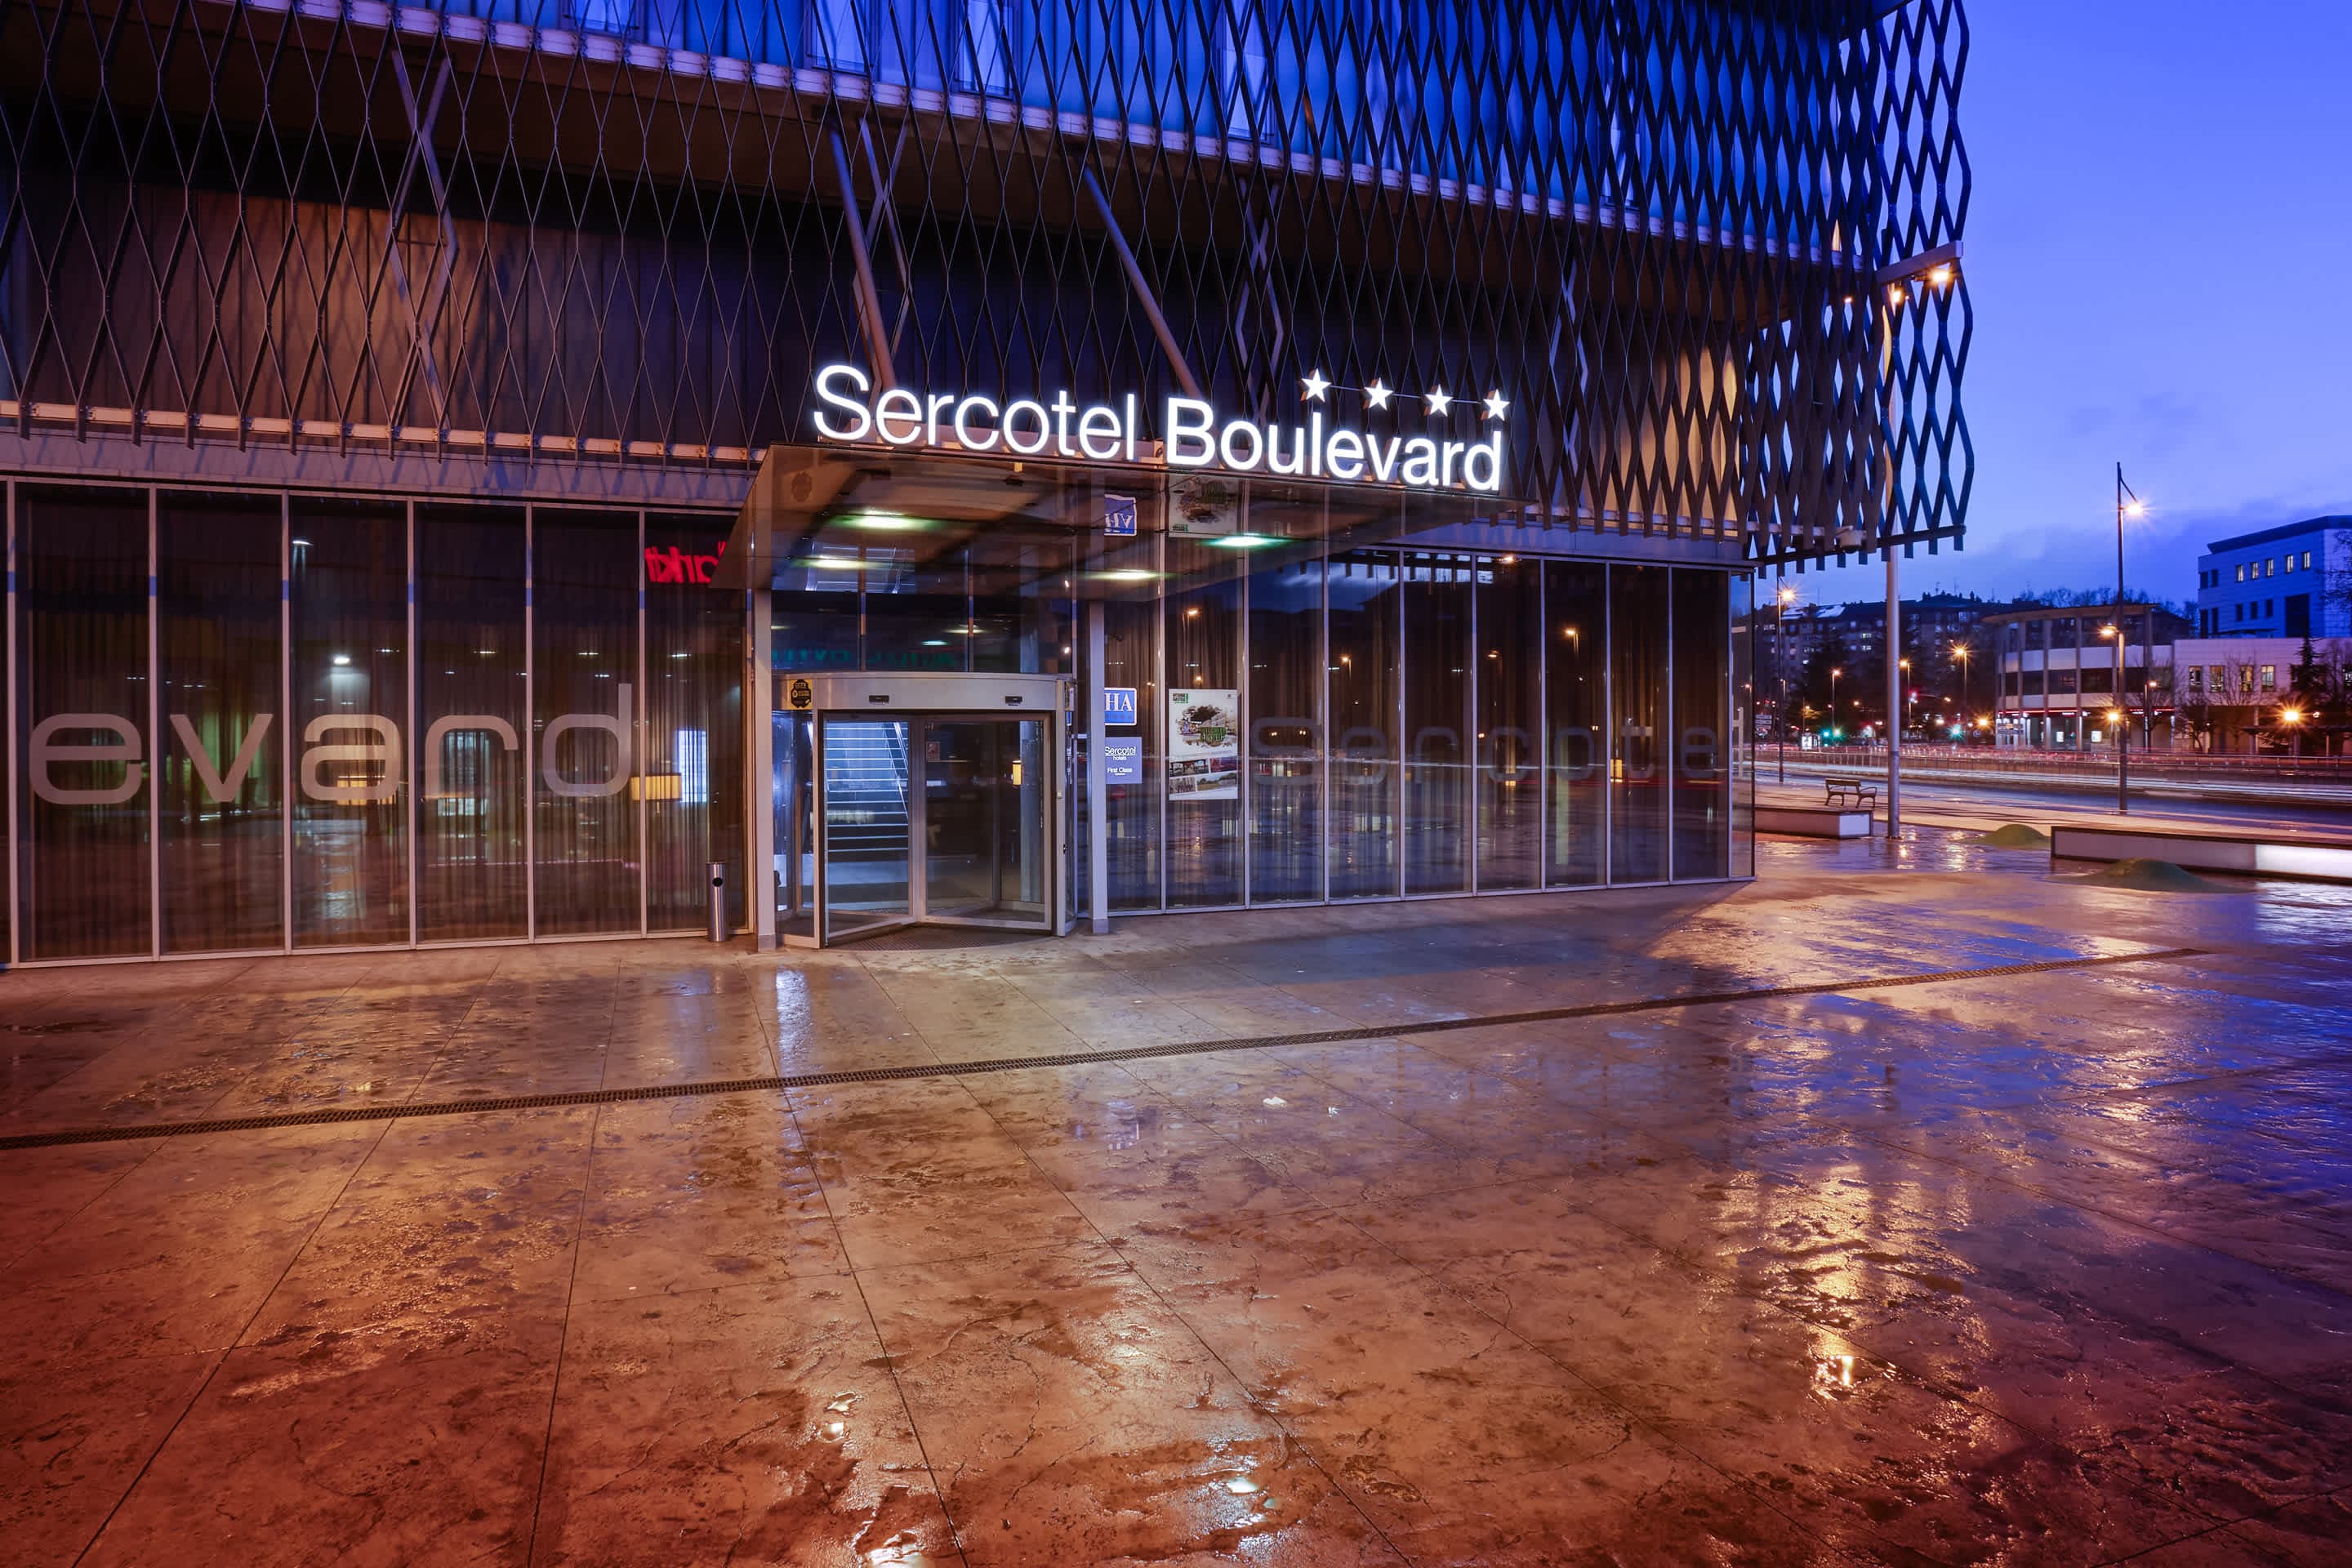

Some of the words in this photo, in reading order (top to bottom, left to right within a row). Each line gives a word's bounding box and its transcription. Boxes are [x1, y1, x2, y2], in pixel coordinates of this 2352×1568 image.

[814, 364, 1136, 461] Sercotel
[1167, 397, 1503, 492] Boulevard
[1104, 693, 1133, 711] HA
[29, 683, 633, 806] evard
[1104, 746, 1136, 755] Sercotel
